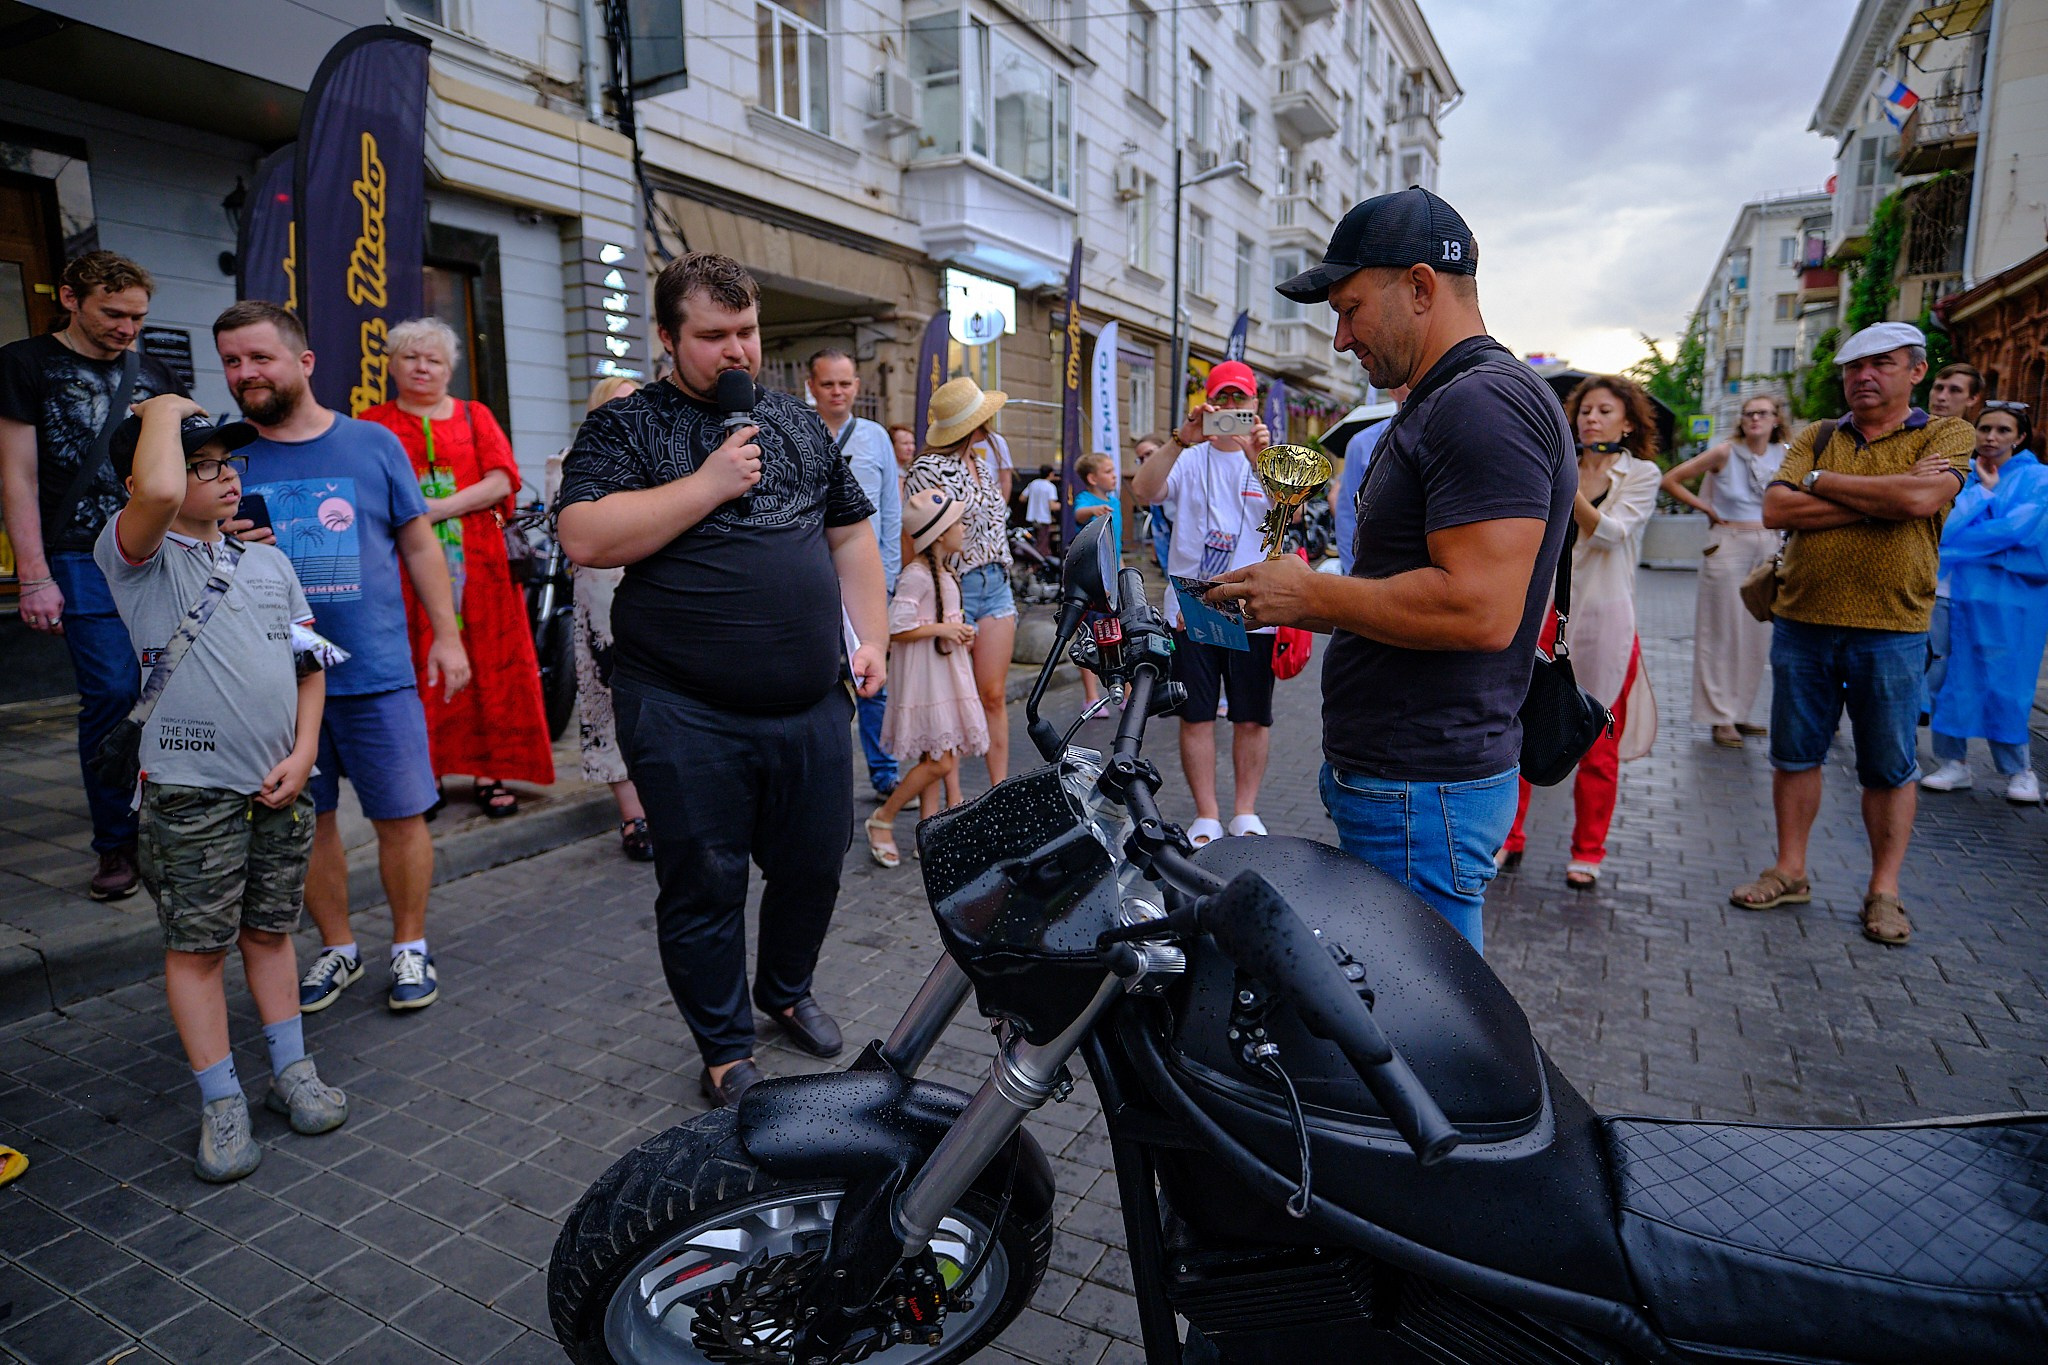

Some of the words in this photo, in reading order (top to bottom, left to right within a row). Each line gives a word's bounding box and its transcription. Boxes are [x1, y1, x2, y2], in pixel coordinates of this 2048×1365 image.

[346, 131, 387, 309] Moto
[1442, 240, 1462, 261] 13
[349, 317, 389, 418] ing
[1098, 350, 1113, 460] EMOTO
[159, 737, 216, 752] VISION
[160, 724, 182, 737] THE
[185, 727, 216, 739] NEW
